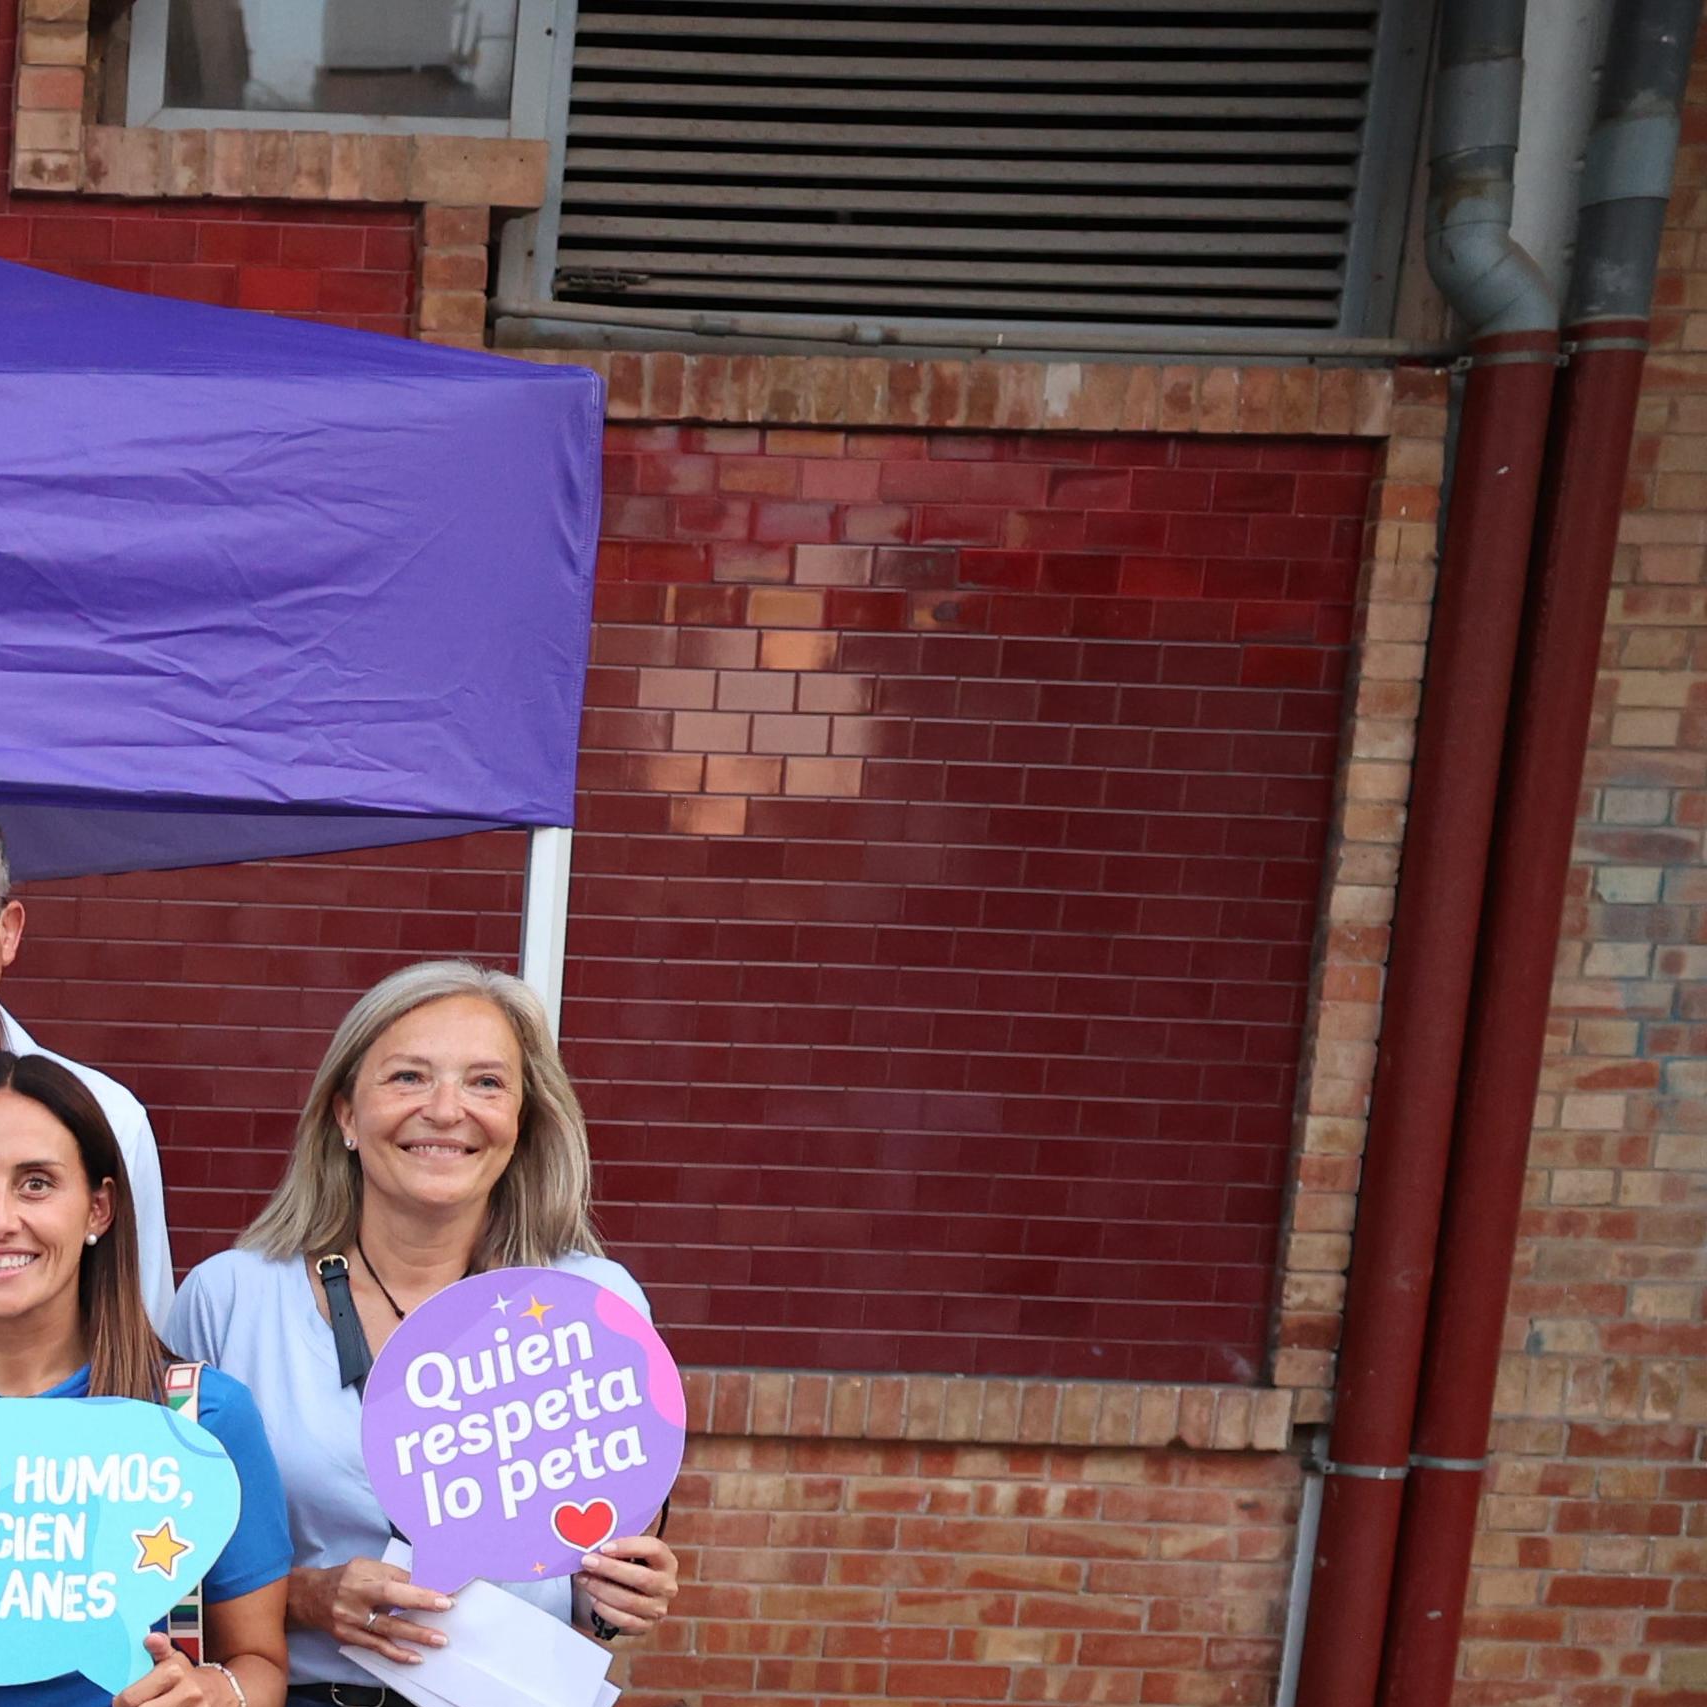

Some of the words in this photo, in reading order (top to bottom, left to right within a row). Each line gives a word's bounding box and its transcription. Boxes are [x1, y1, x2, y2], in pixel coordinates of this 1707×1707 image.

[405, 1321, 594, 1412] Quien
[395, 1366, 642, 1477] respeta
[13, 1453, 194, 1510] HUMOS,
[421, 1471, 483, 1528] lo
[497, 1425, 648, 1520] peta
